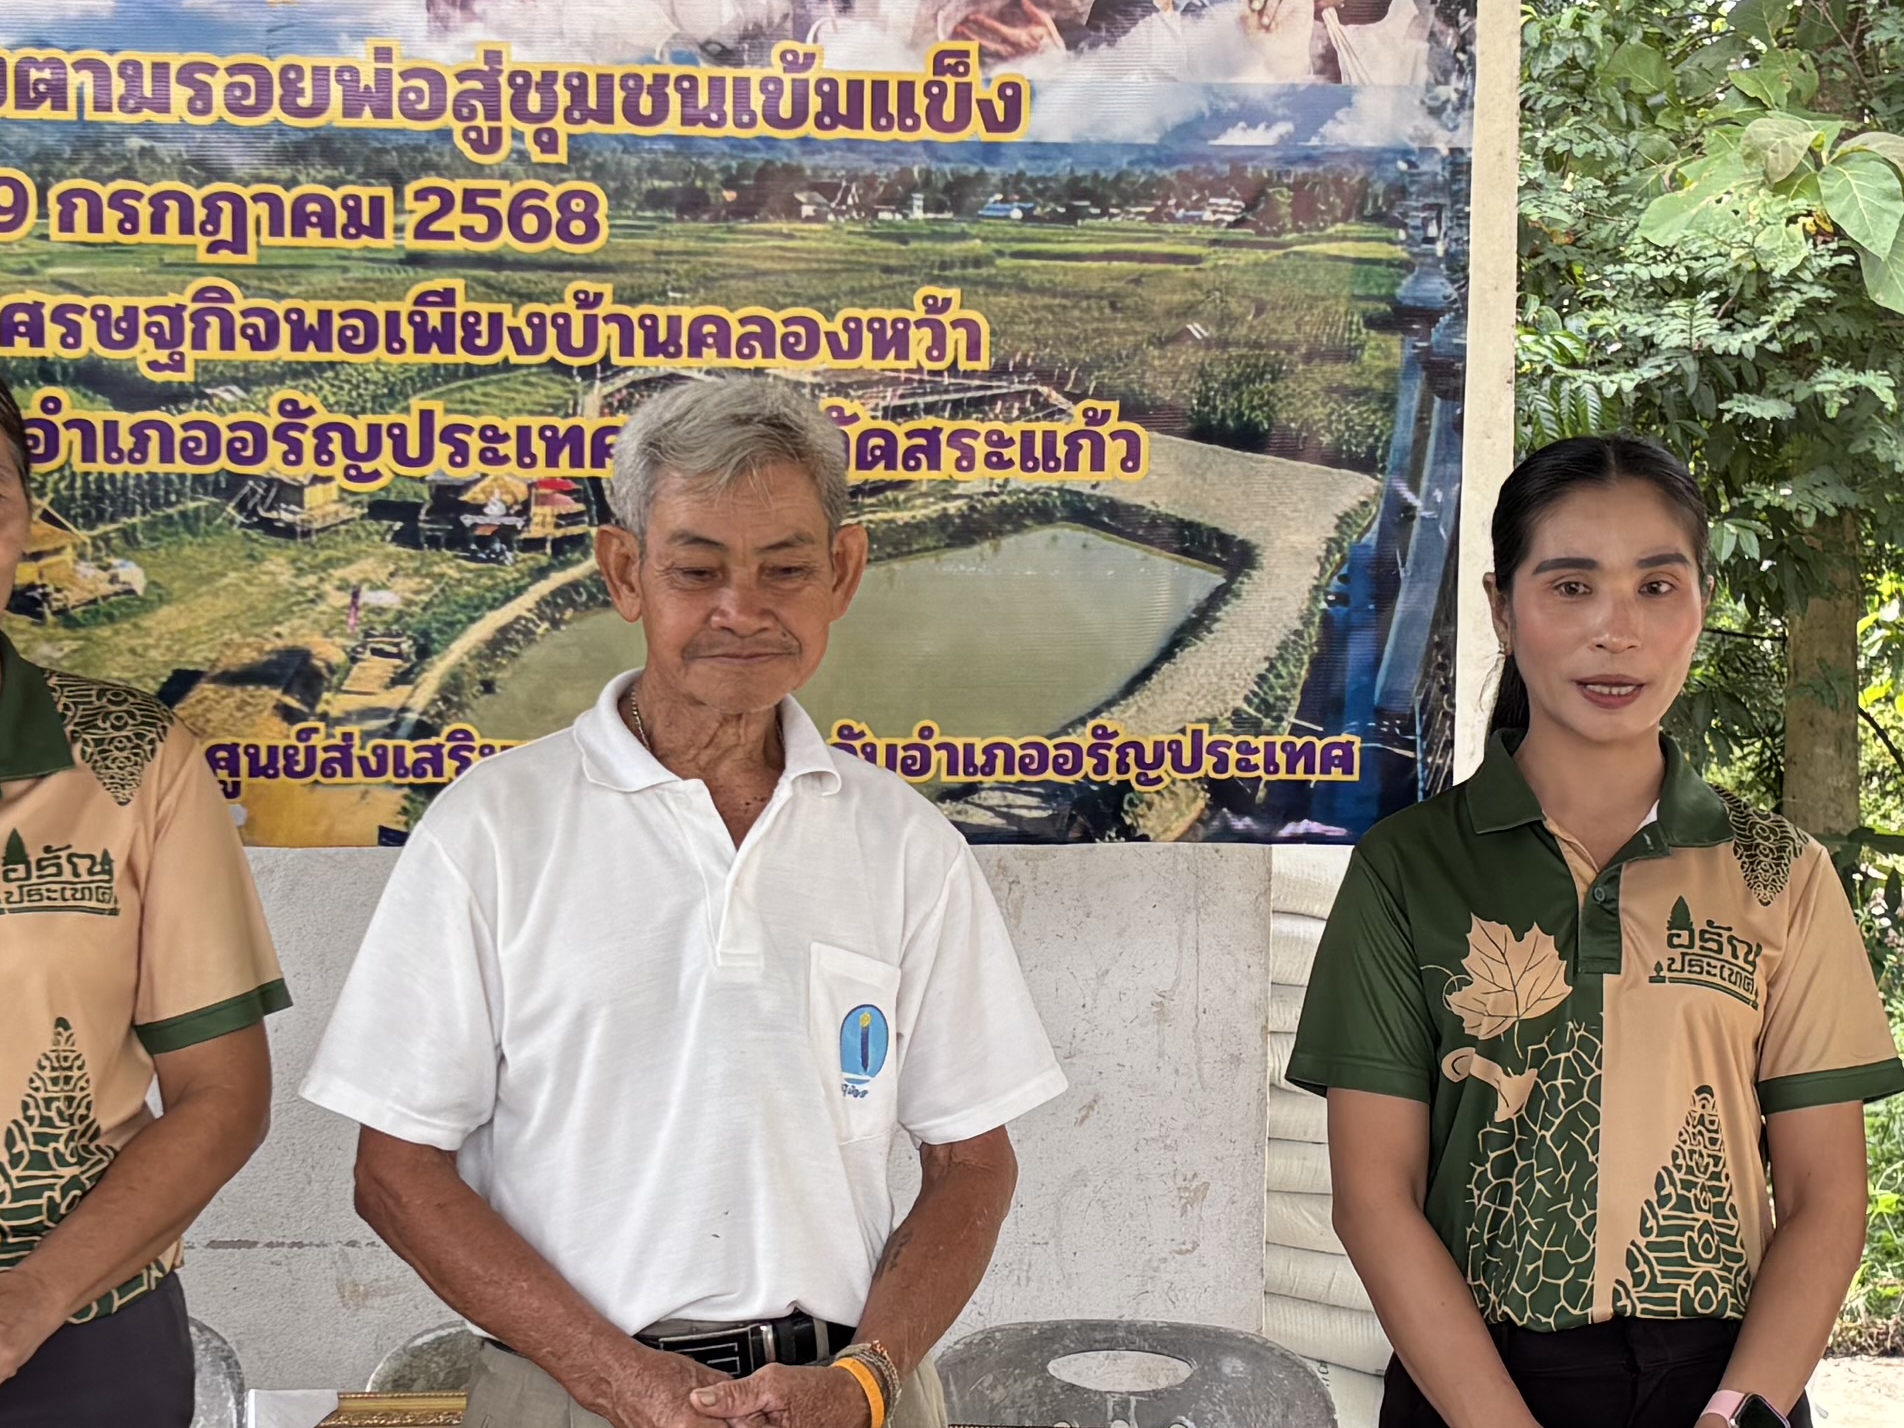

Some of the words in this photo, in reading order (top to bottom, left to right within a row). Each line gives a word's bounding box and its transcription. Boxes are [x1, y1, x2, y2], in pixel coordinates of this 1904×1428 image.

[57, 186, 386, 255] กรกฎาคม
[413, 186, 602, 246] 2568
[825, 404, 1142, 474] ัดสระแก้ว
